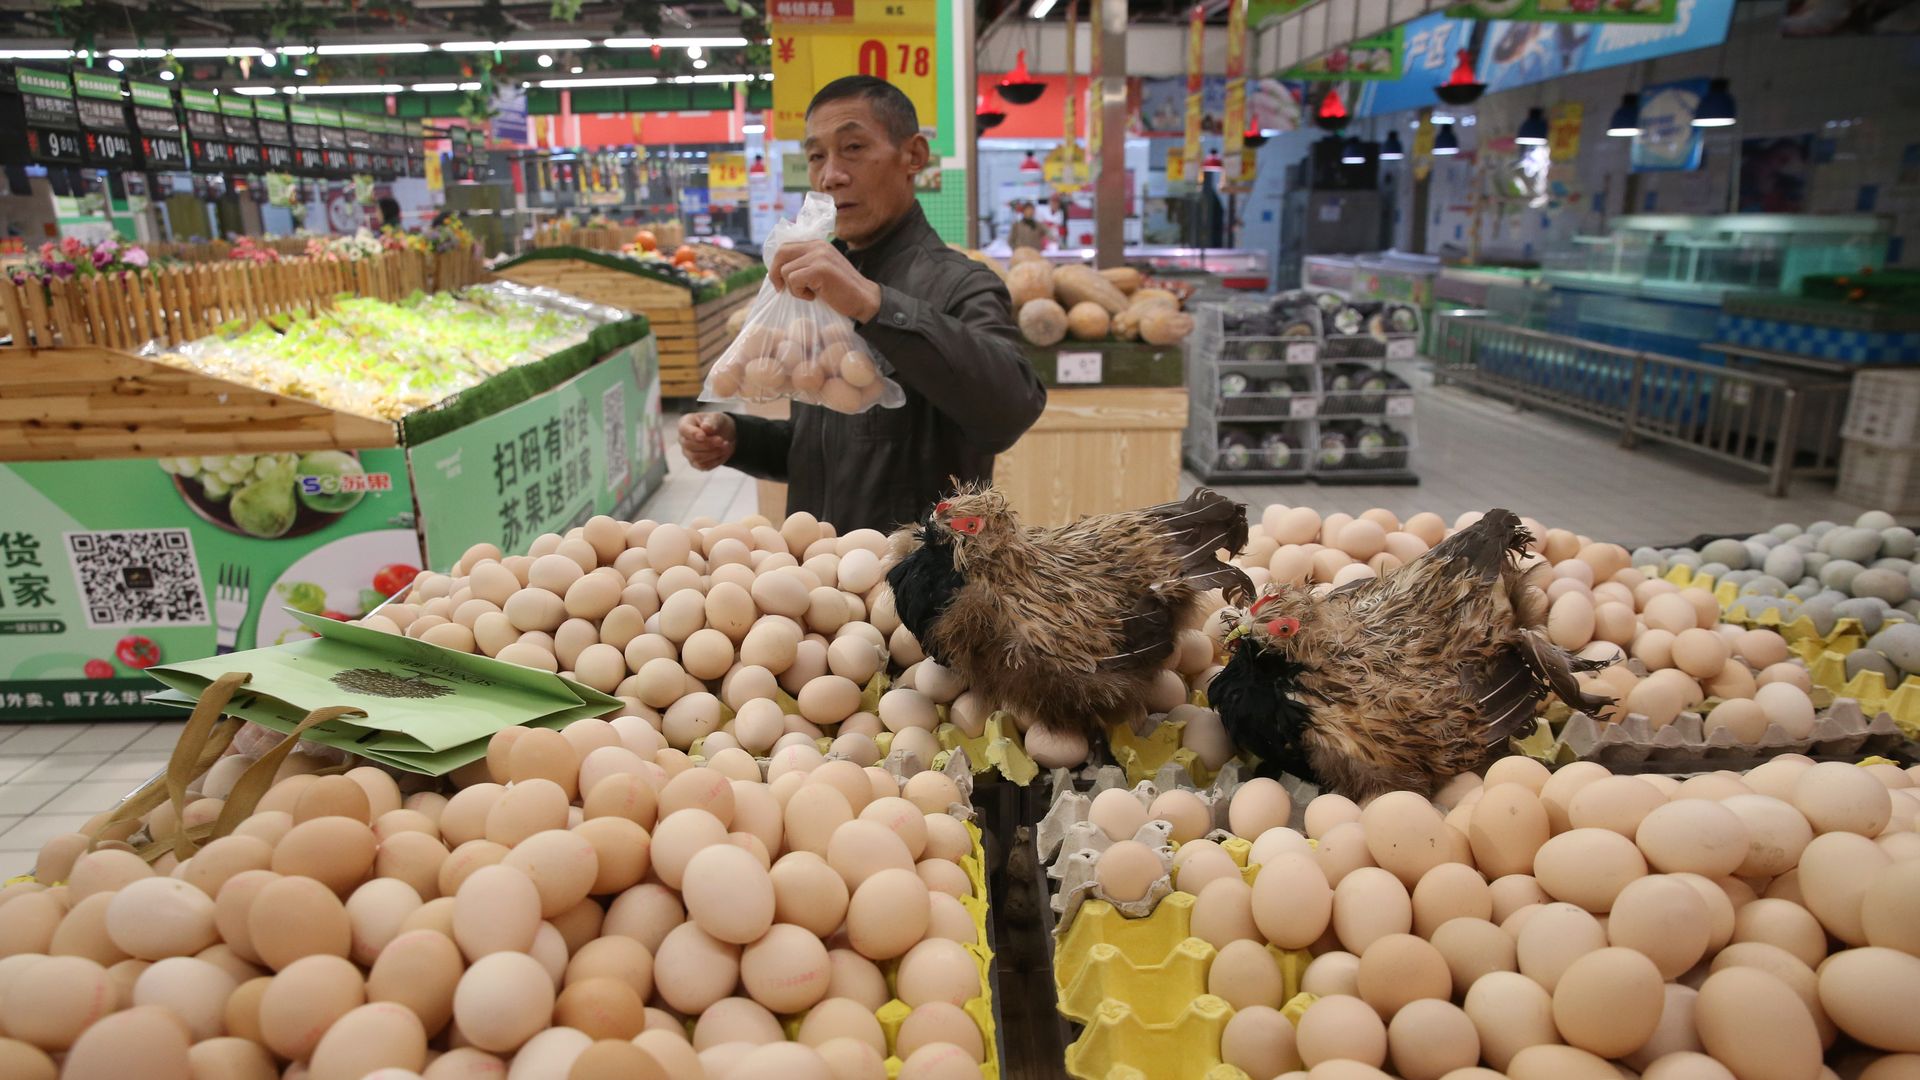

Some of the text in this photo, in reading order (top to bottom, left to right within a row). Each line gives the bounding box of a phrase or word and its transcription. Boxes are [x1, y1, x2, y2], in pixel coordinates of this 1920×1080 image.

[499, 446, 592, 552] 苏果送到家
[0, 573, 55, 608] 家
